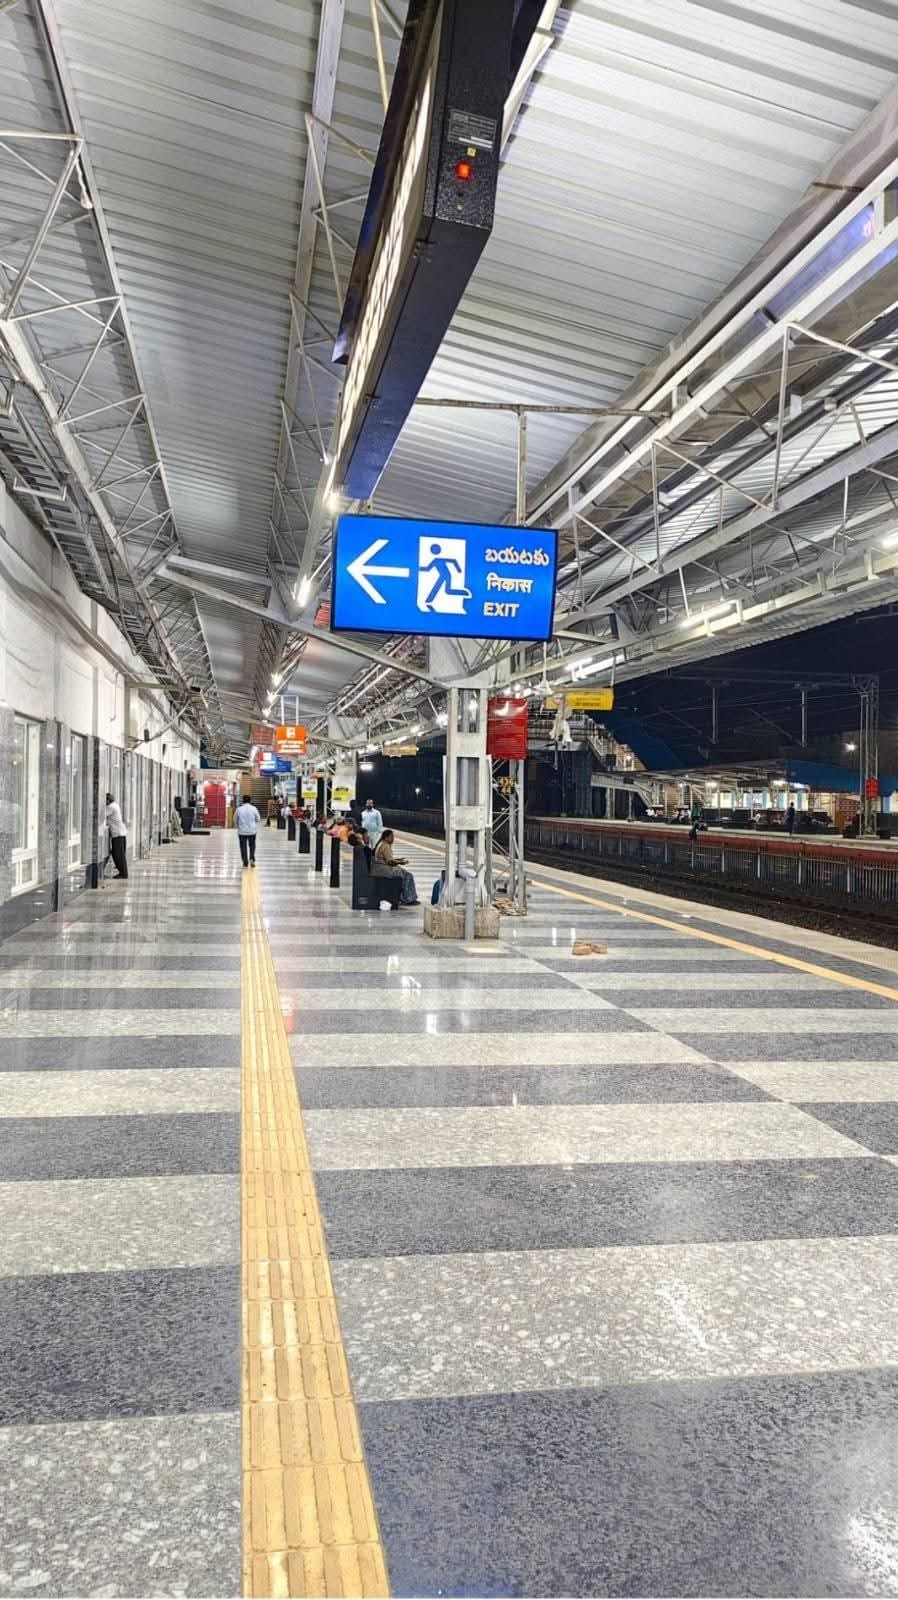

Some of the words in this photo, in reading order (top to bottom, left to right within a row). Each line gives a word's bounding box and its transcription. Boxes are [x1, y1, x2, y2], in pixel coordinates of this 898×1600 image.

[485, 546, 550, 567] బయటకు
[486, 572, 534, 594] निकास
[483, 602, 520, 618] EXIT
